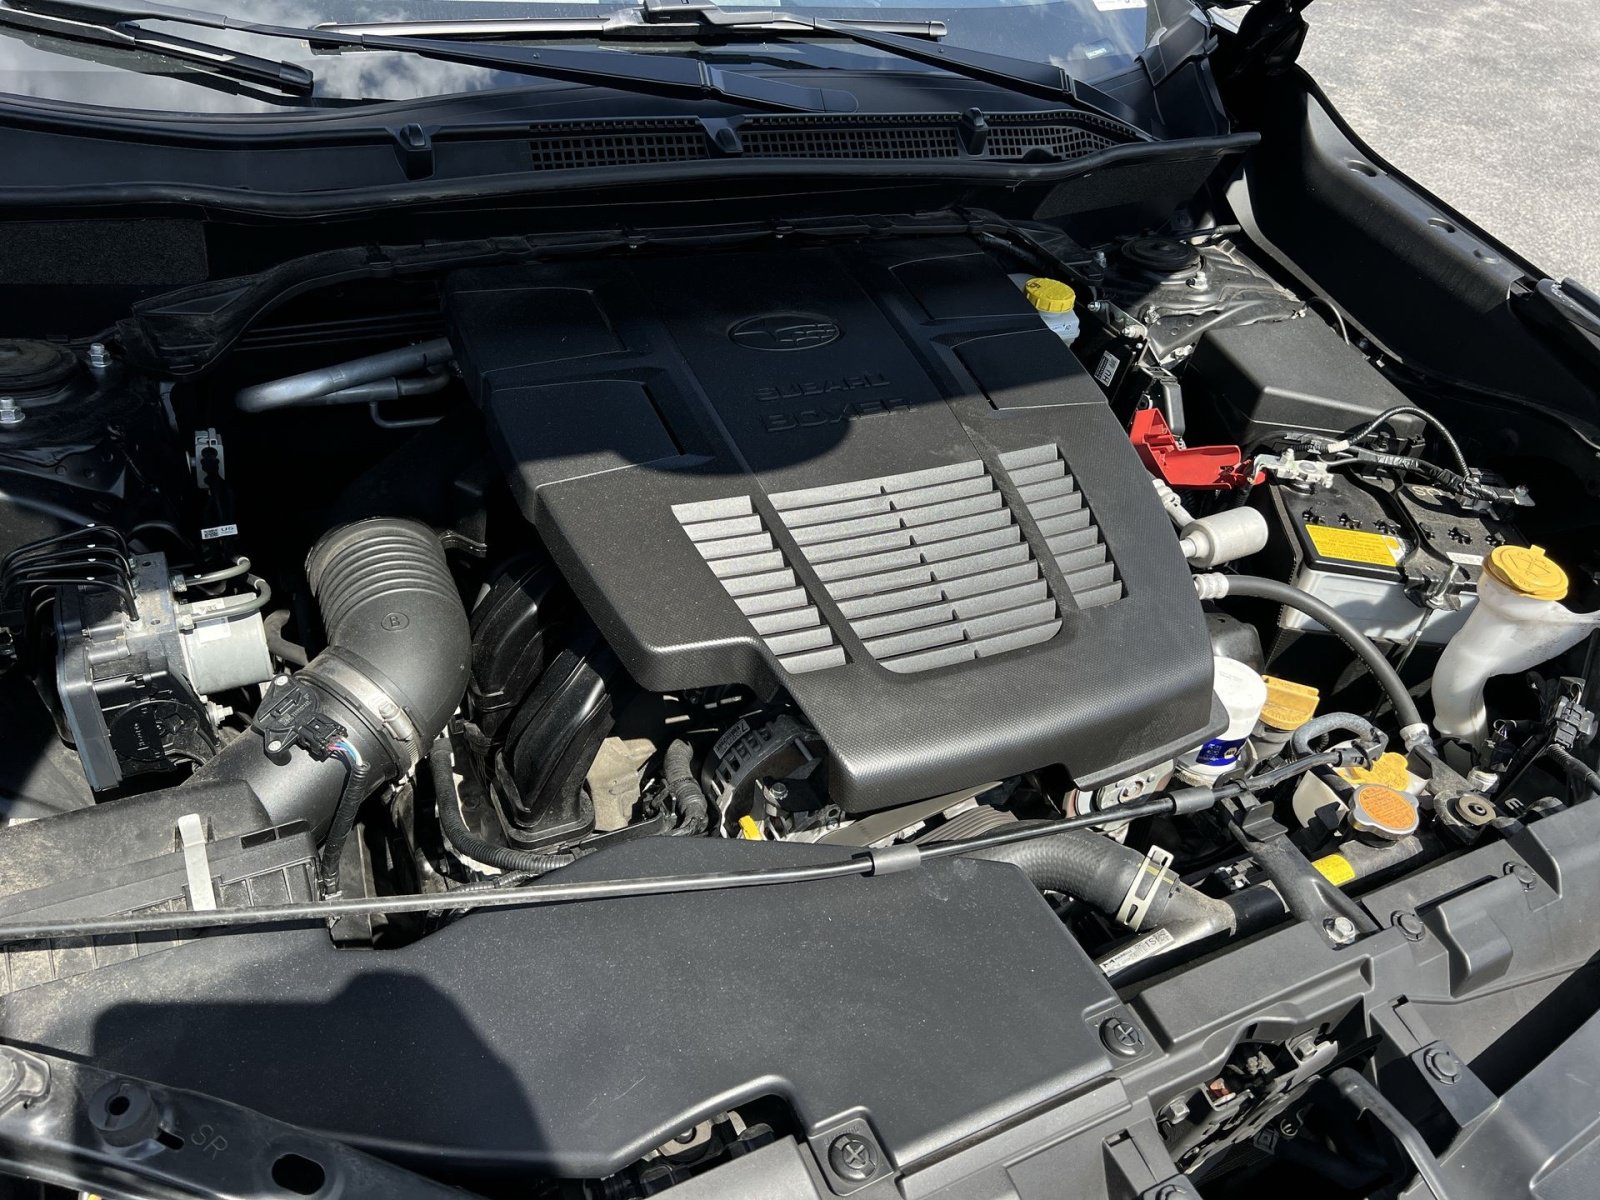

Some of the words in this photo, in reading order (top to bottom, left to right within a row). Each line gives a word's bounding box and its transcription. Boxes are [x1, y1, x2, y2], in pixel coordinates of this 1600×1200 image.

[754, 371, 891, 402] SUBARU
[760, 396, 918, 432] BOXER
[190, 1124, 229, 1161] SR
